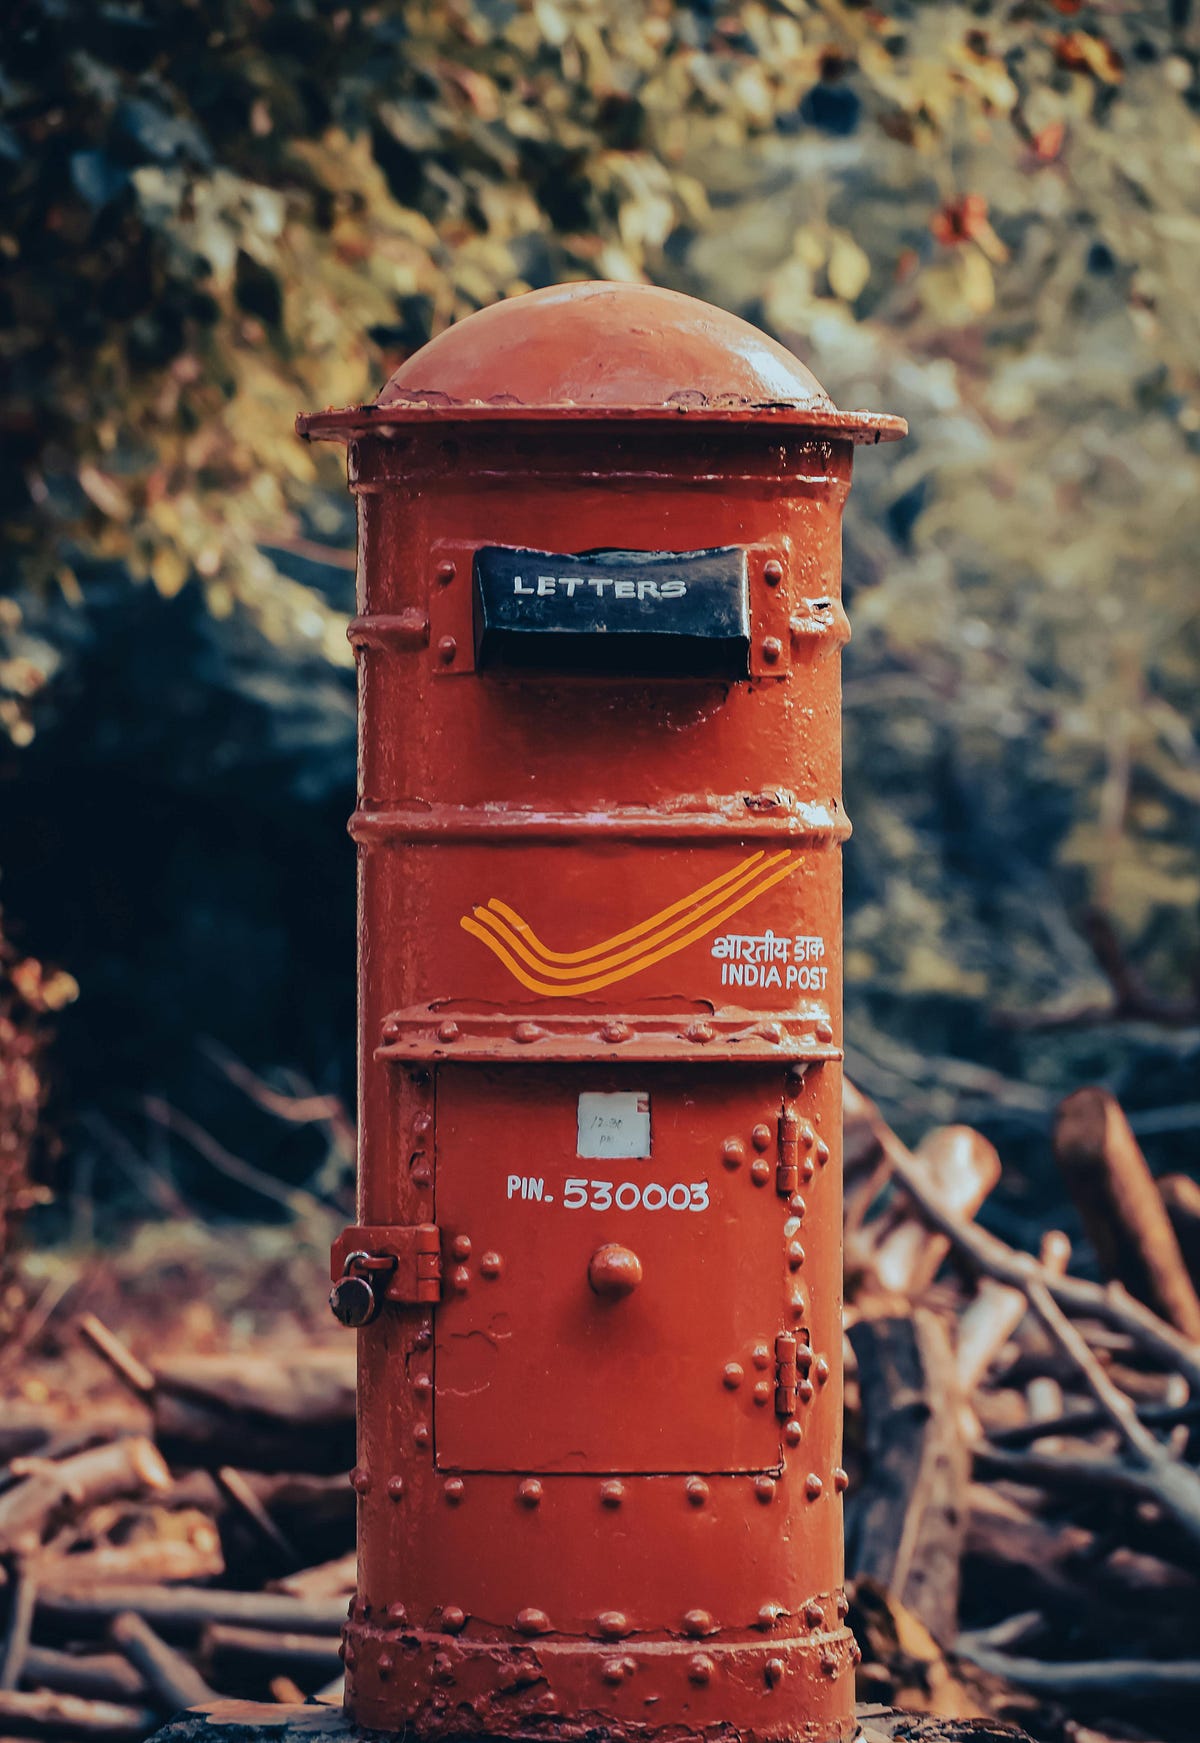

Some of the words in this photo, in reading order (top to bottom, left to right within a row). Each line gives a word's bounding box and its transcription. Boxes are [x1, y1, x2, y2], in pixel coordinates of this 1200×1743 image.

[513, 576, 687, 600] LETTERS
[711, 929, 792, 964] भारतीय
[794, 935, 825, 962] डाक
[721, 963, 782, 989] INDIA
[786, 965, 828, 990] POST
[507, 1175, 554, 1202] PIN.
[563, 1178, 709, 1211] 530003
